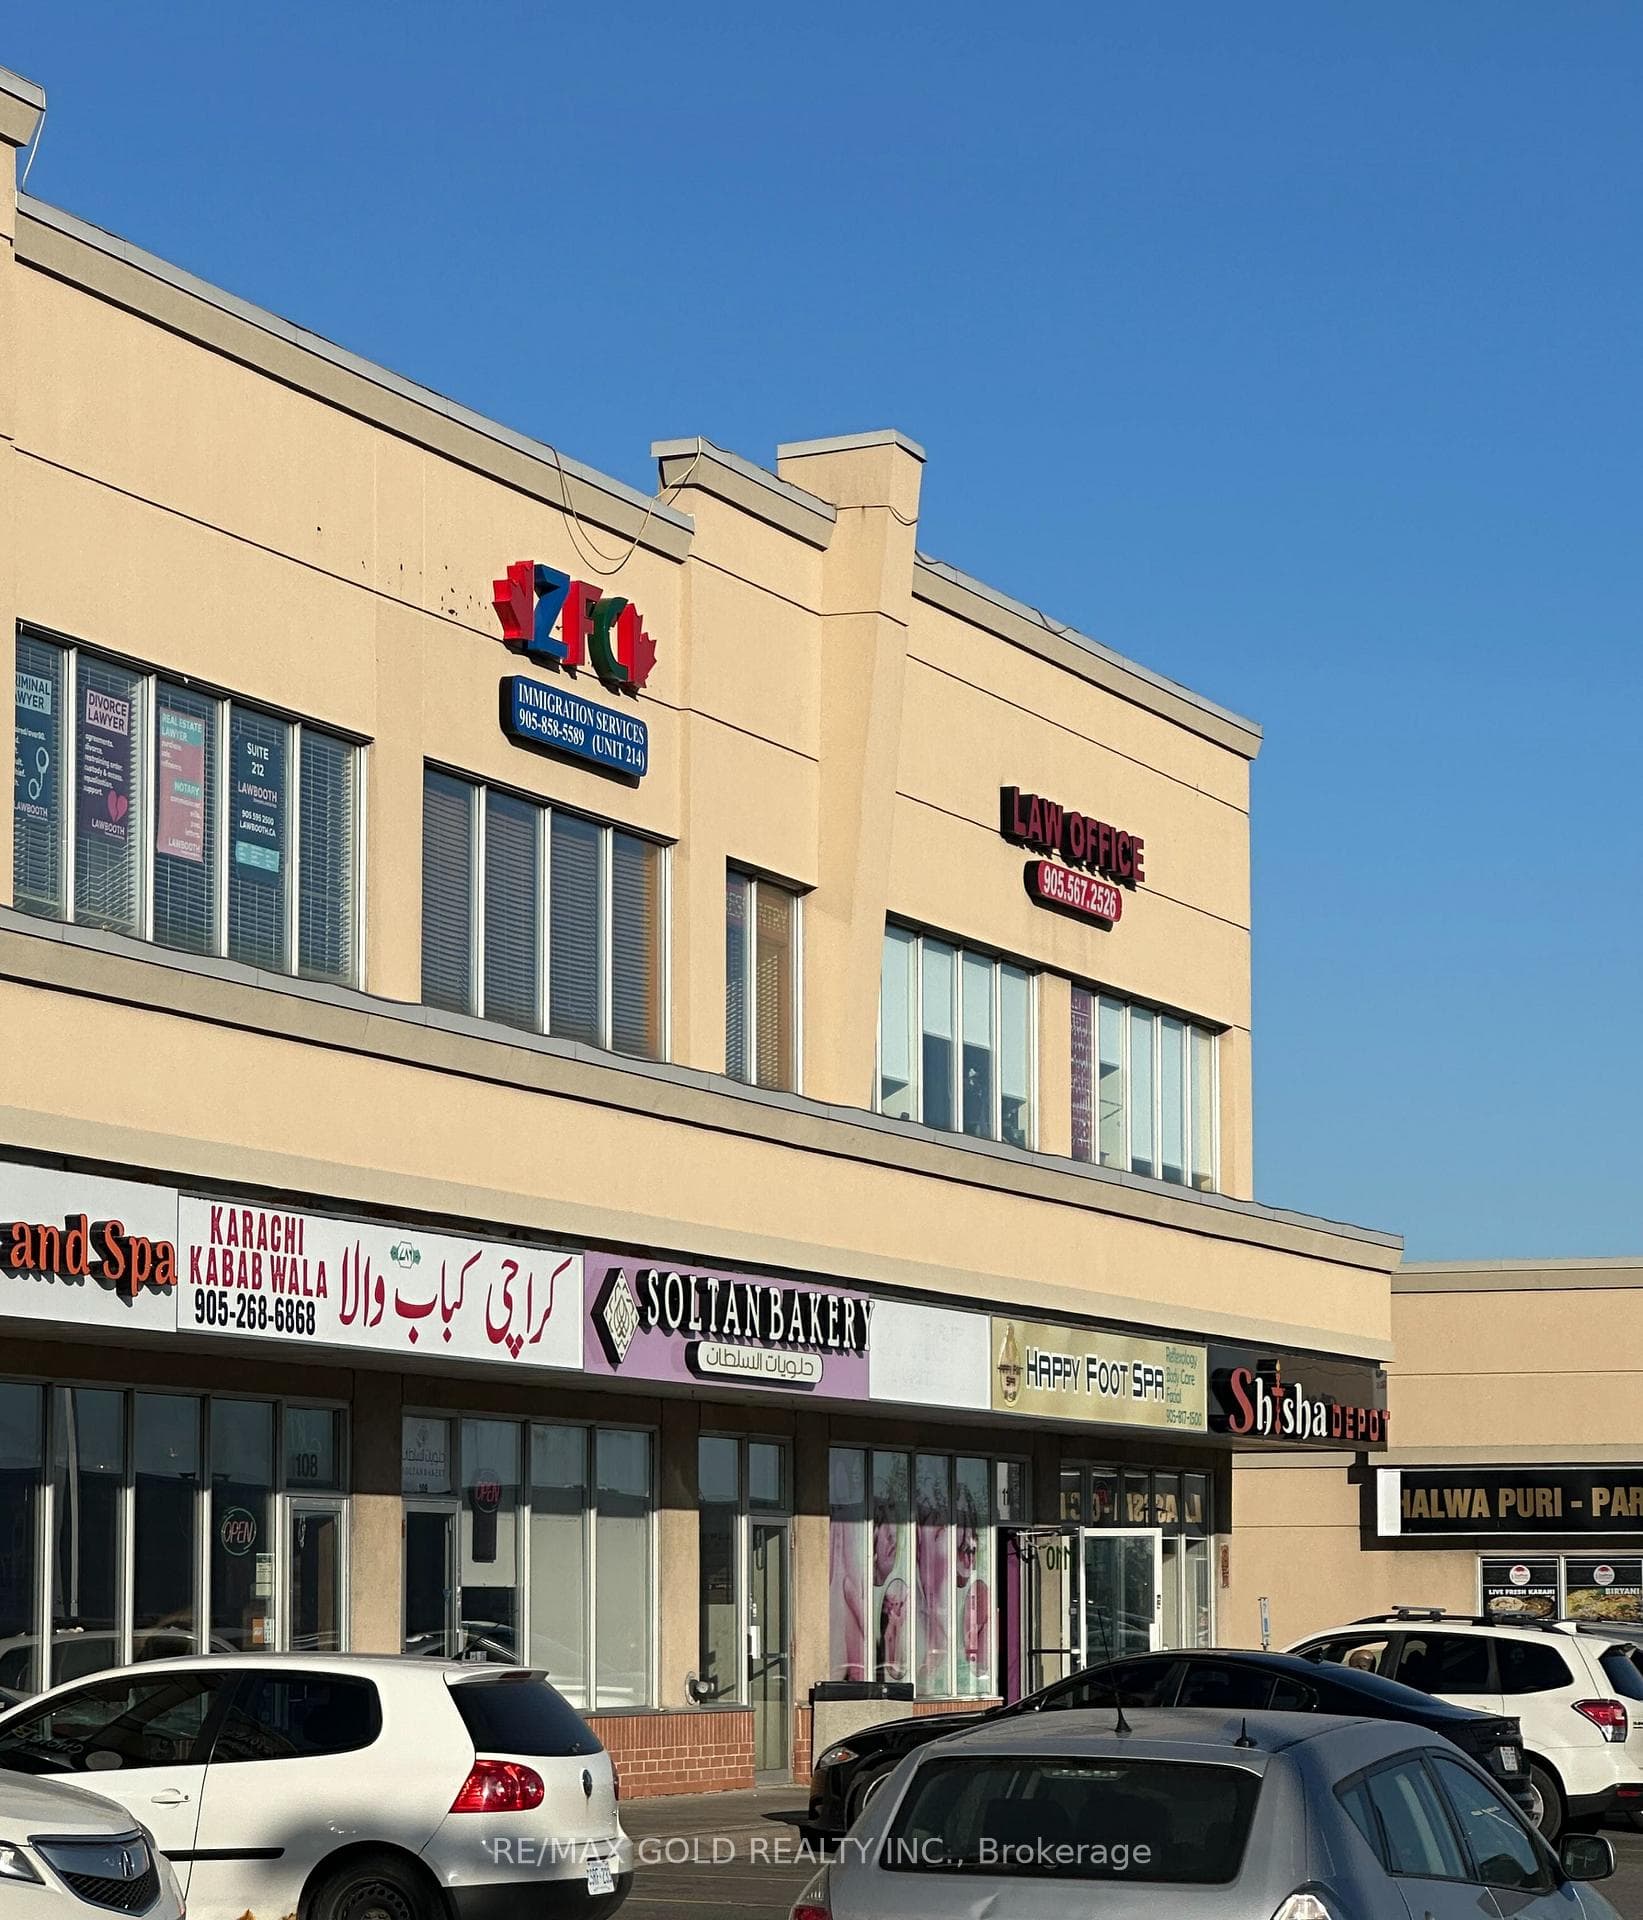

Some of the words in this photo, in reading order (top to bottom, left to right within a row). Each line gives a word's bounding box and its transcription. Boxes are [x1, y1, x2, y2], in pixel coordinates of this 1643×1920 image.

[528, 564, 628, 682] ZFC
[89, 692, 127, 717] DIVORCE
[518, 683, 594, 727] IMMIGRATION
[596, 712, 645, 745] SERVICES
[88, 709, 124, 732] LAWYER
[161, 727, 188, 742] LAWYER
[162, 713, 178, 727] REAL
[179, 720, 203, 734] ESTATE
[247, 742, 269, 760] SUITE
[519, 708, 585, 746] 905-858-5589
[592, 735, 624, 761] (UNIT
[626, 747, 645, 773] 214)
[251, 762, 264, 777] 212
[173, 780, 200, 797] NOTARY
[238, 781, 278, 803] LAWBOOTH
[91, 818, 125, 836] LAWBOOTH
[1013, 786, 1064, 849] LAW
[1069, 811, 1146, 882] OFFICE
[1043, 865, 1117, 918] 905.567.2526
[210, 1205, 304, 1257] KARACHI
[10, 1213, 90, 1275] and
[102, 1219, 178, 1298] Spa
[190, 1245, 263, 1290] KABAB
[269, 1254, 328, 1298] WALA
[194, 1289, 316, 1336] 905-268-6868
[1026, 1348, 1081, 1391] HAPPY
[1086, 1356, 1128, 1397] FOOT
[1132, 1362, 1165, 1400] SPA
[1229, 1367, 1328, 1440] Shisha
[474, 1480, 501, 1503] OPEN
[1498, 1487, 1563, 1518] PURI
[1571, 1500, 1582, 1508] -
[223, 1520, 253, 1544] OPEN
[1605, 1587, 1640, 1595] BIRYANI
